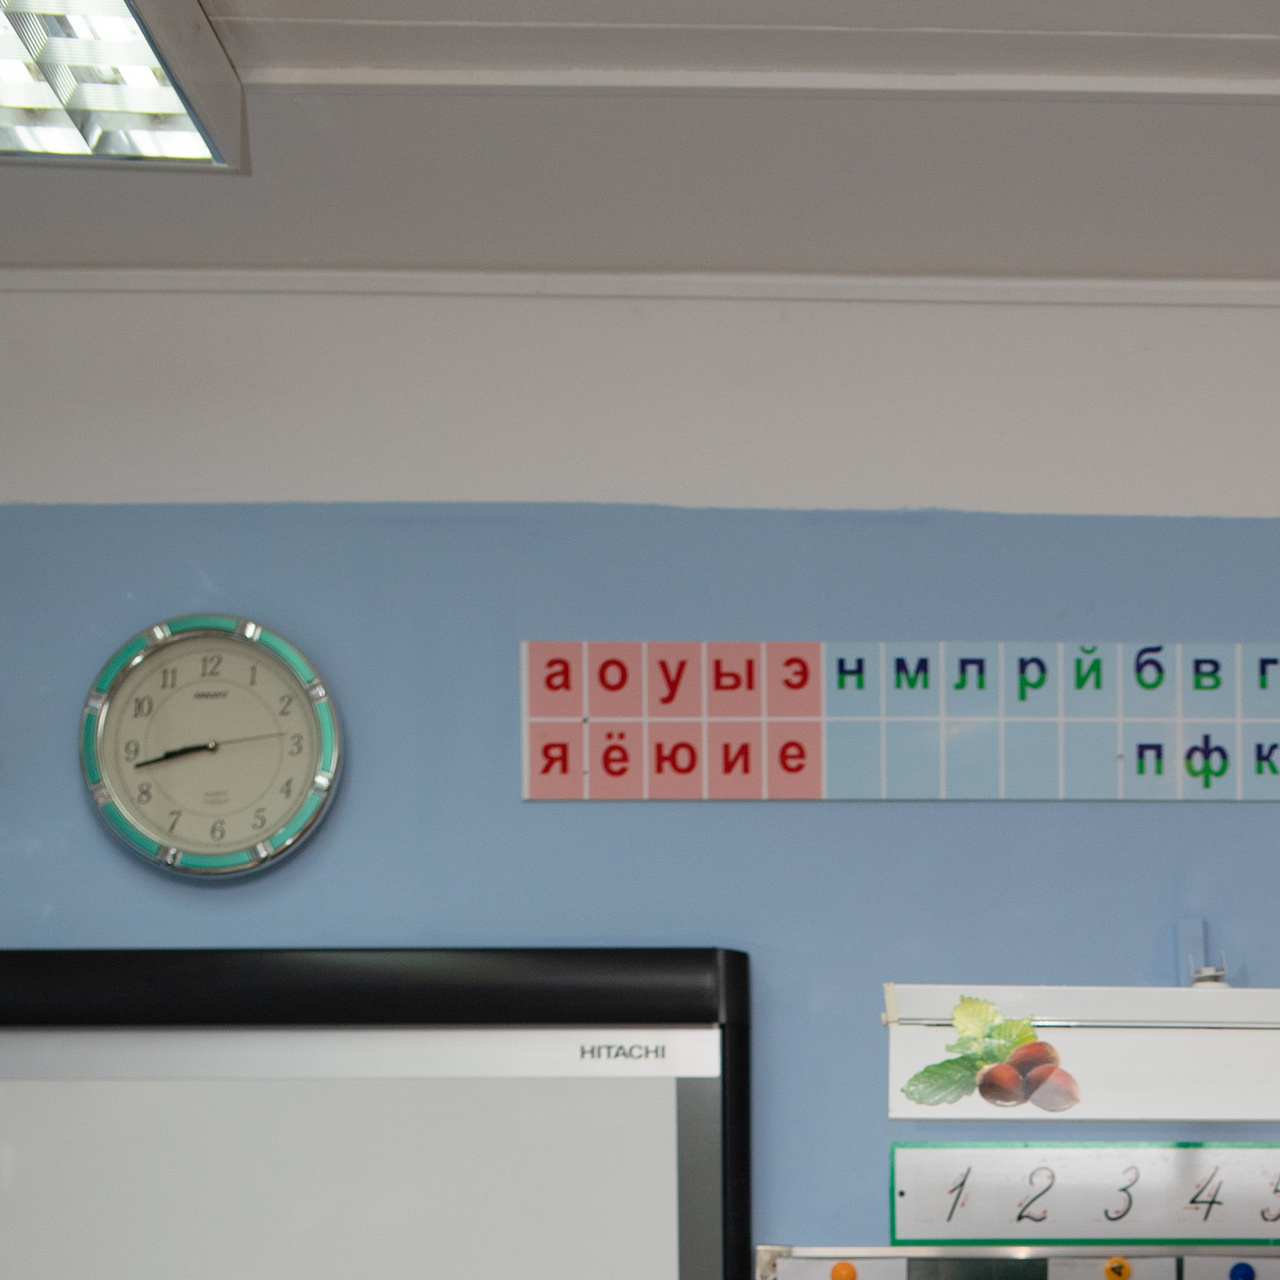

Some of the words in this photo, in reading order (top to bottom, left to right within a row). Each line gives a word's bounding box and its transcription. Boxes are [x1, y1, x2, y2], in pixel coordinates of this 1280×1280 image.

[200, 654, 222, 677] 12
[249, 666, 257, 685] 1
[545, 658, 571, 691] а
[598, 659, 628, 692] о
[659, 660, 687, 703] у
[714, 659, 754, 691] ы
[784, 657, 809, 690] э
[838, 658, 863, 689] н
[896, 658, 928, 688] м
[955, 659, 984, 689] л
[1019, 658, 1046, 700] р
[1076, 646, 1101, 689] й
[1136, 646, 1163, 689] б
[1194, 659, 1220, 689] в
[1260, 658, 1278, 689] г
[161, 667, 177, 689] 11
[132, 696, 153, 718] 10
[279, 694, 293, 716] 2
[125, 741, 140, 762] 9
[288, 734, 303, 756] 3
[542, 743, 568, 774] я
[602, 732, 629, 777] ё
[656, 742, 697, 774] ю
[723, 743, 750, 774] и
[779, 741, 806, 773] е
[1138, 744, 1162, 774] п
[1185, 734, 1228, 788] ф
[1257, 744, 1278, 774] к
[137, 782, 151, 804] 8
[280, 778, 292, 798] 4
[168, 810, 182, 832] 7
[210, 819, 225, 840] 6
[252, 808, 266, 830] 5
[580, 1045, 665, 1058] HITACHI
[946, 1167, 971, 1223] 1
[1016, 1167, 1056, 1223] 2
[1103, 1167, 1140, 1223] 3
[1189, 1167, 1224, 1223] 4
